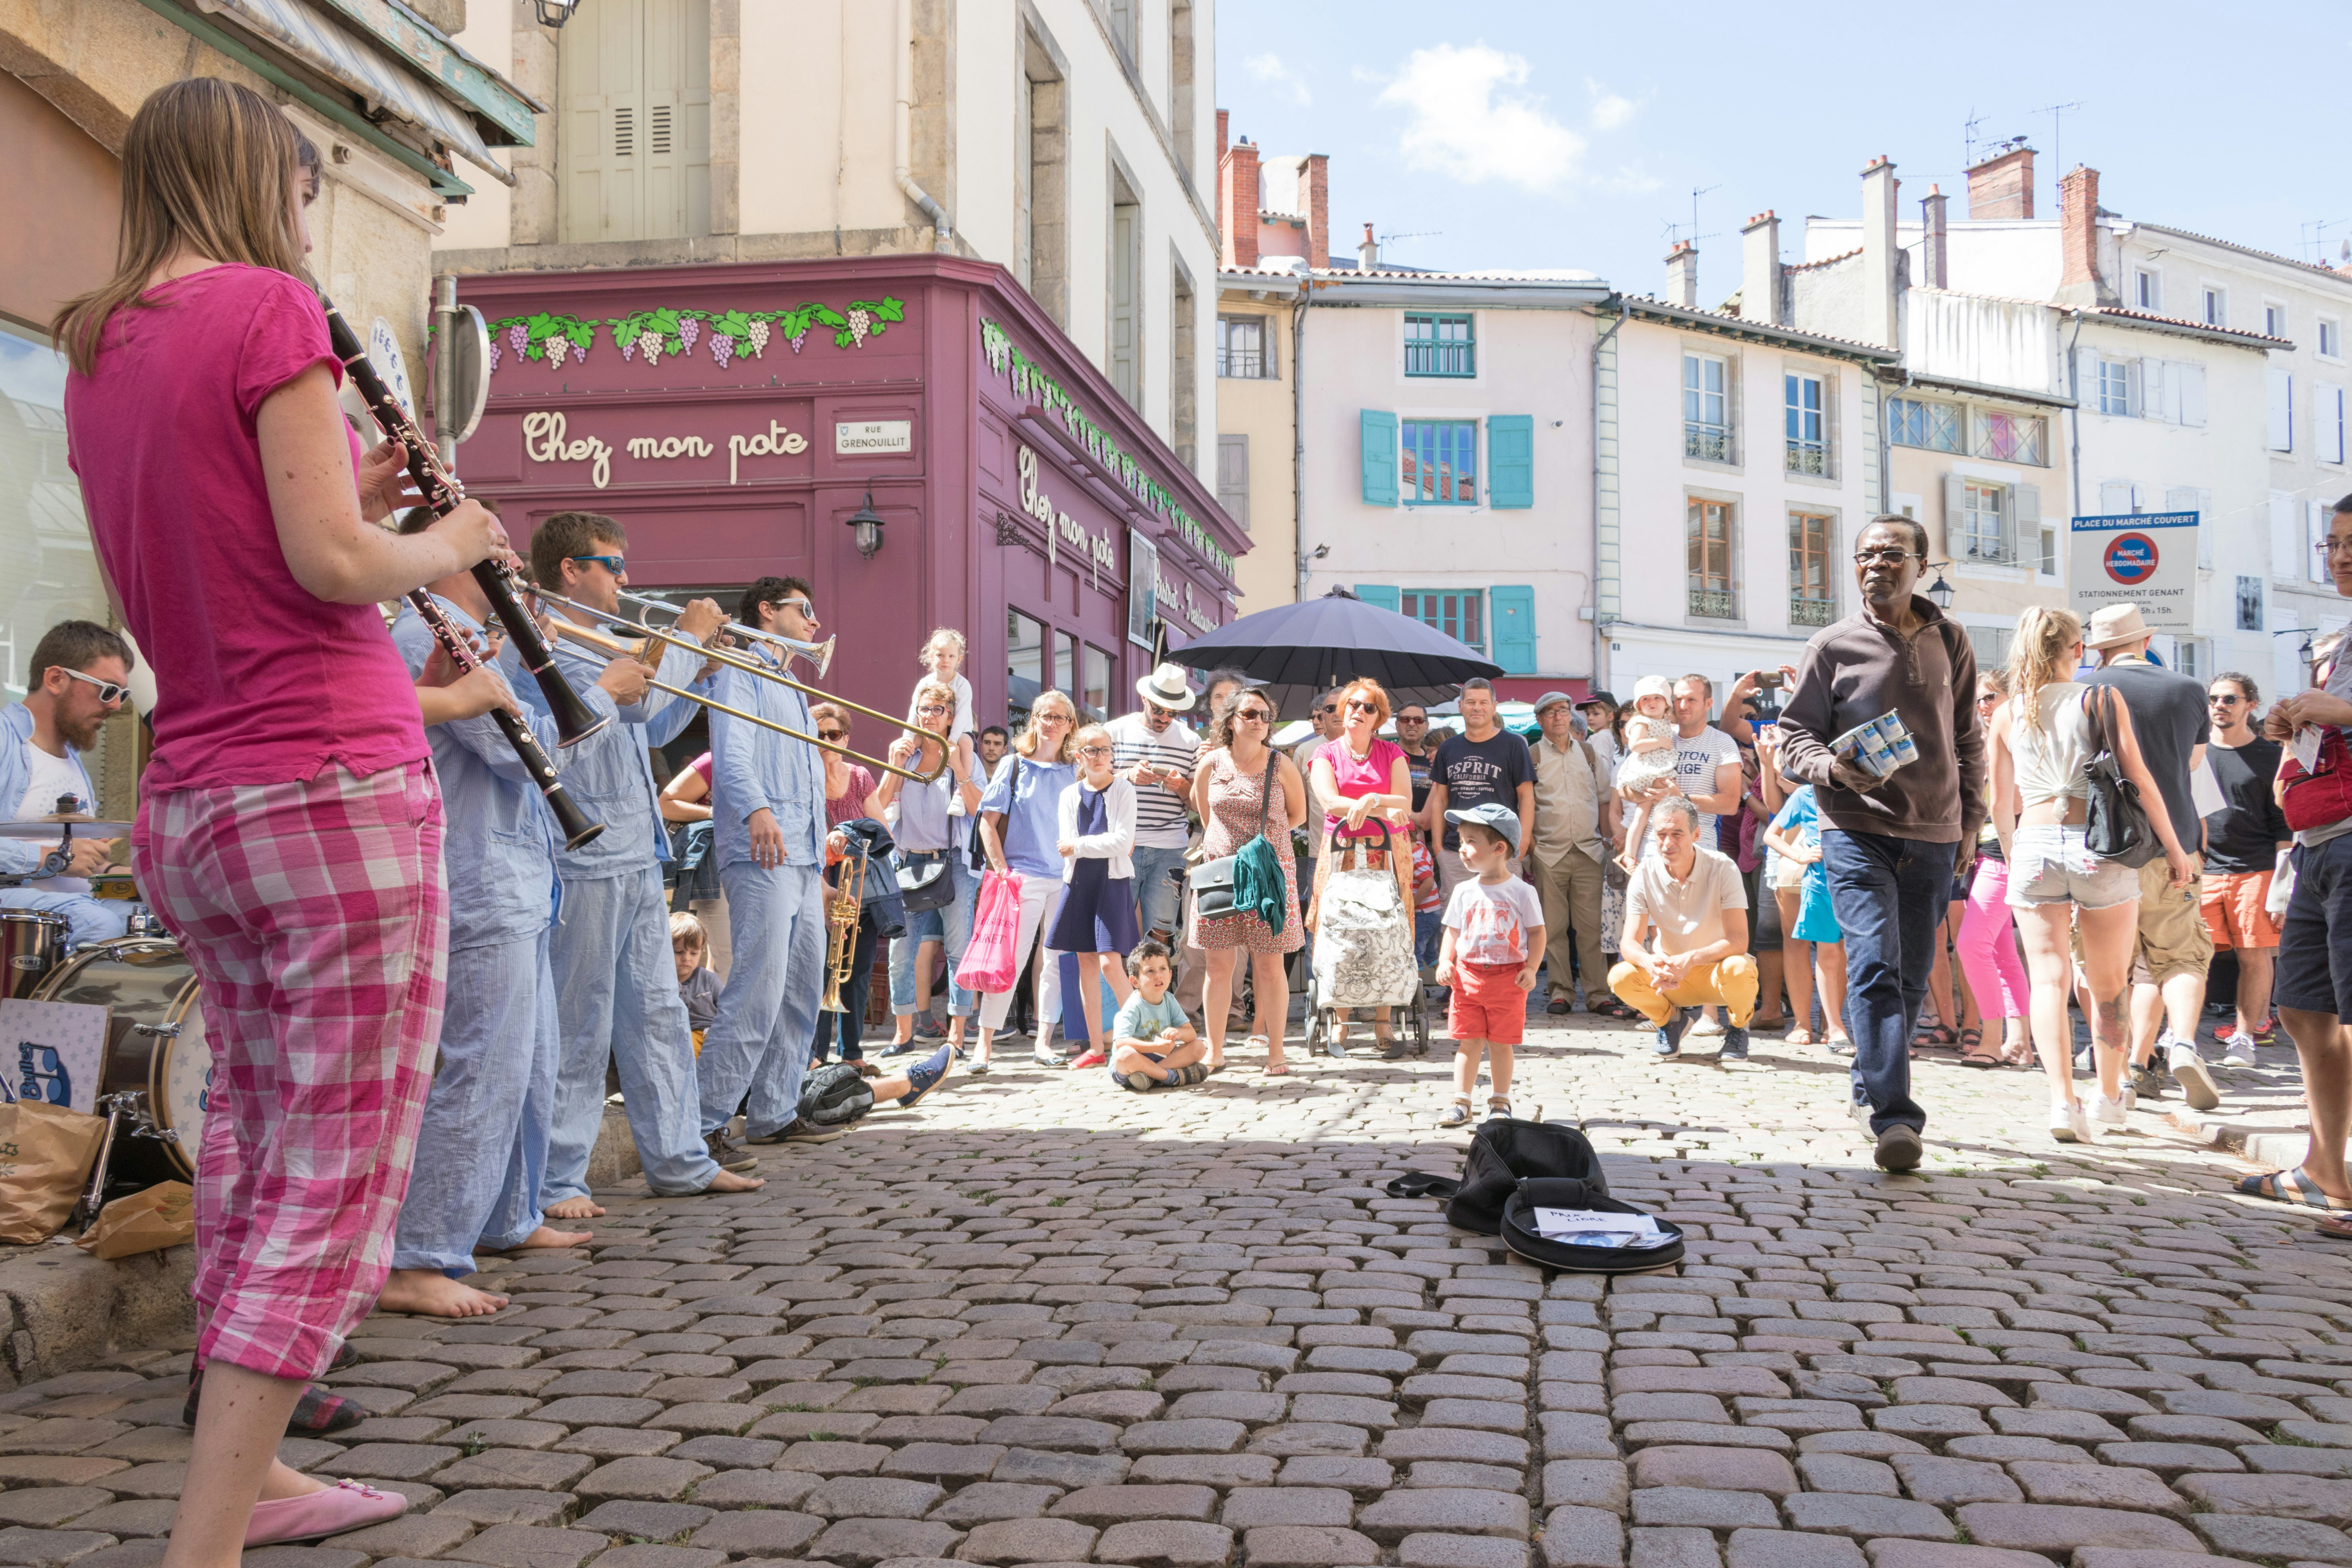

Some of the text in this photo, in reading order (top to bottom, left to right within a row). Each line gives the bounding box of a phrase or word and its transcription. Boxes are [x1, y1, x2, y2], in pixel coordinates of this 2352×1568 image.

[841, 437, 905, 448] GRENOUILLIT
[523, 412, 808, 489] Chez mon pote
[1019, 445, 1114, 591] Chez mon pote
[2074, 520, 2101, 528] PLACE
[2116, 515, 2152, 526] MARCHÉ
[2154, 515, 2195, 524] COUVERT
[2117, 548, 2144, 557] MARCHÉ
[2106, 559, 2156, 567] HEBDOMADAIRE
[2078, 590, 2147, 598] STATIONNEMENT
[1447, 761, 1502, 779] ESPRIT
[1674, 763, 1701, 774] UGE
